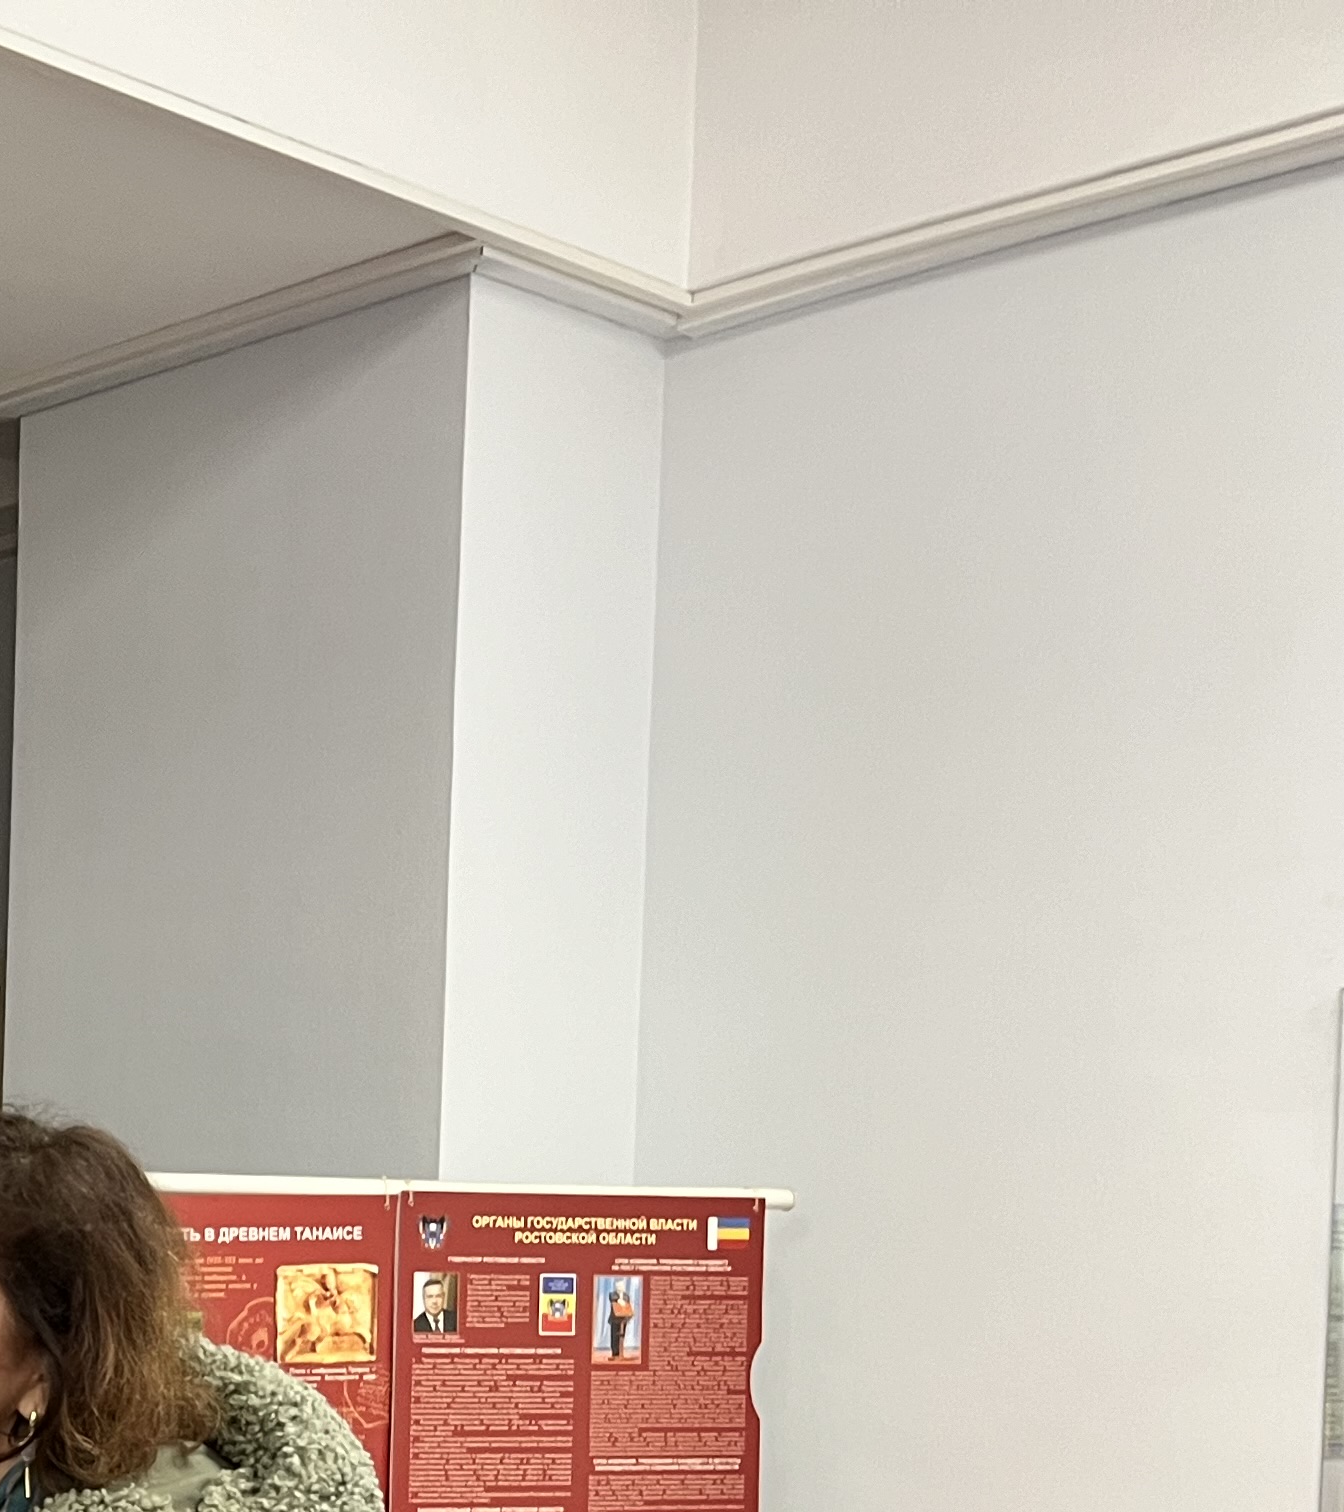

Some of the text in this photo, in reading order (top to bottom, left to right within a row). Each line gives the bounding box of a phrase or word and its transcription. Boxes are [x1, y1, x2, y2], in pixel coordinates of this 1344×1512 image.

[472, 1215, 698, 1232] ОРГАНЫ ГОСУДАРСТВЕННОЙ ВЛАСТИ
[204, 1228, 215, 1242] В
[217, 1227, 291, 1244] ДРЕВНЕМ
[294, 1226, 363, 1241] ТАНАИСЕ
[514, 1229, 657, 1246] РОСТОВСКОЙ ОБЛАСТИ
